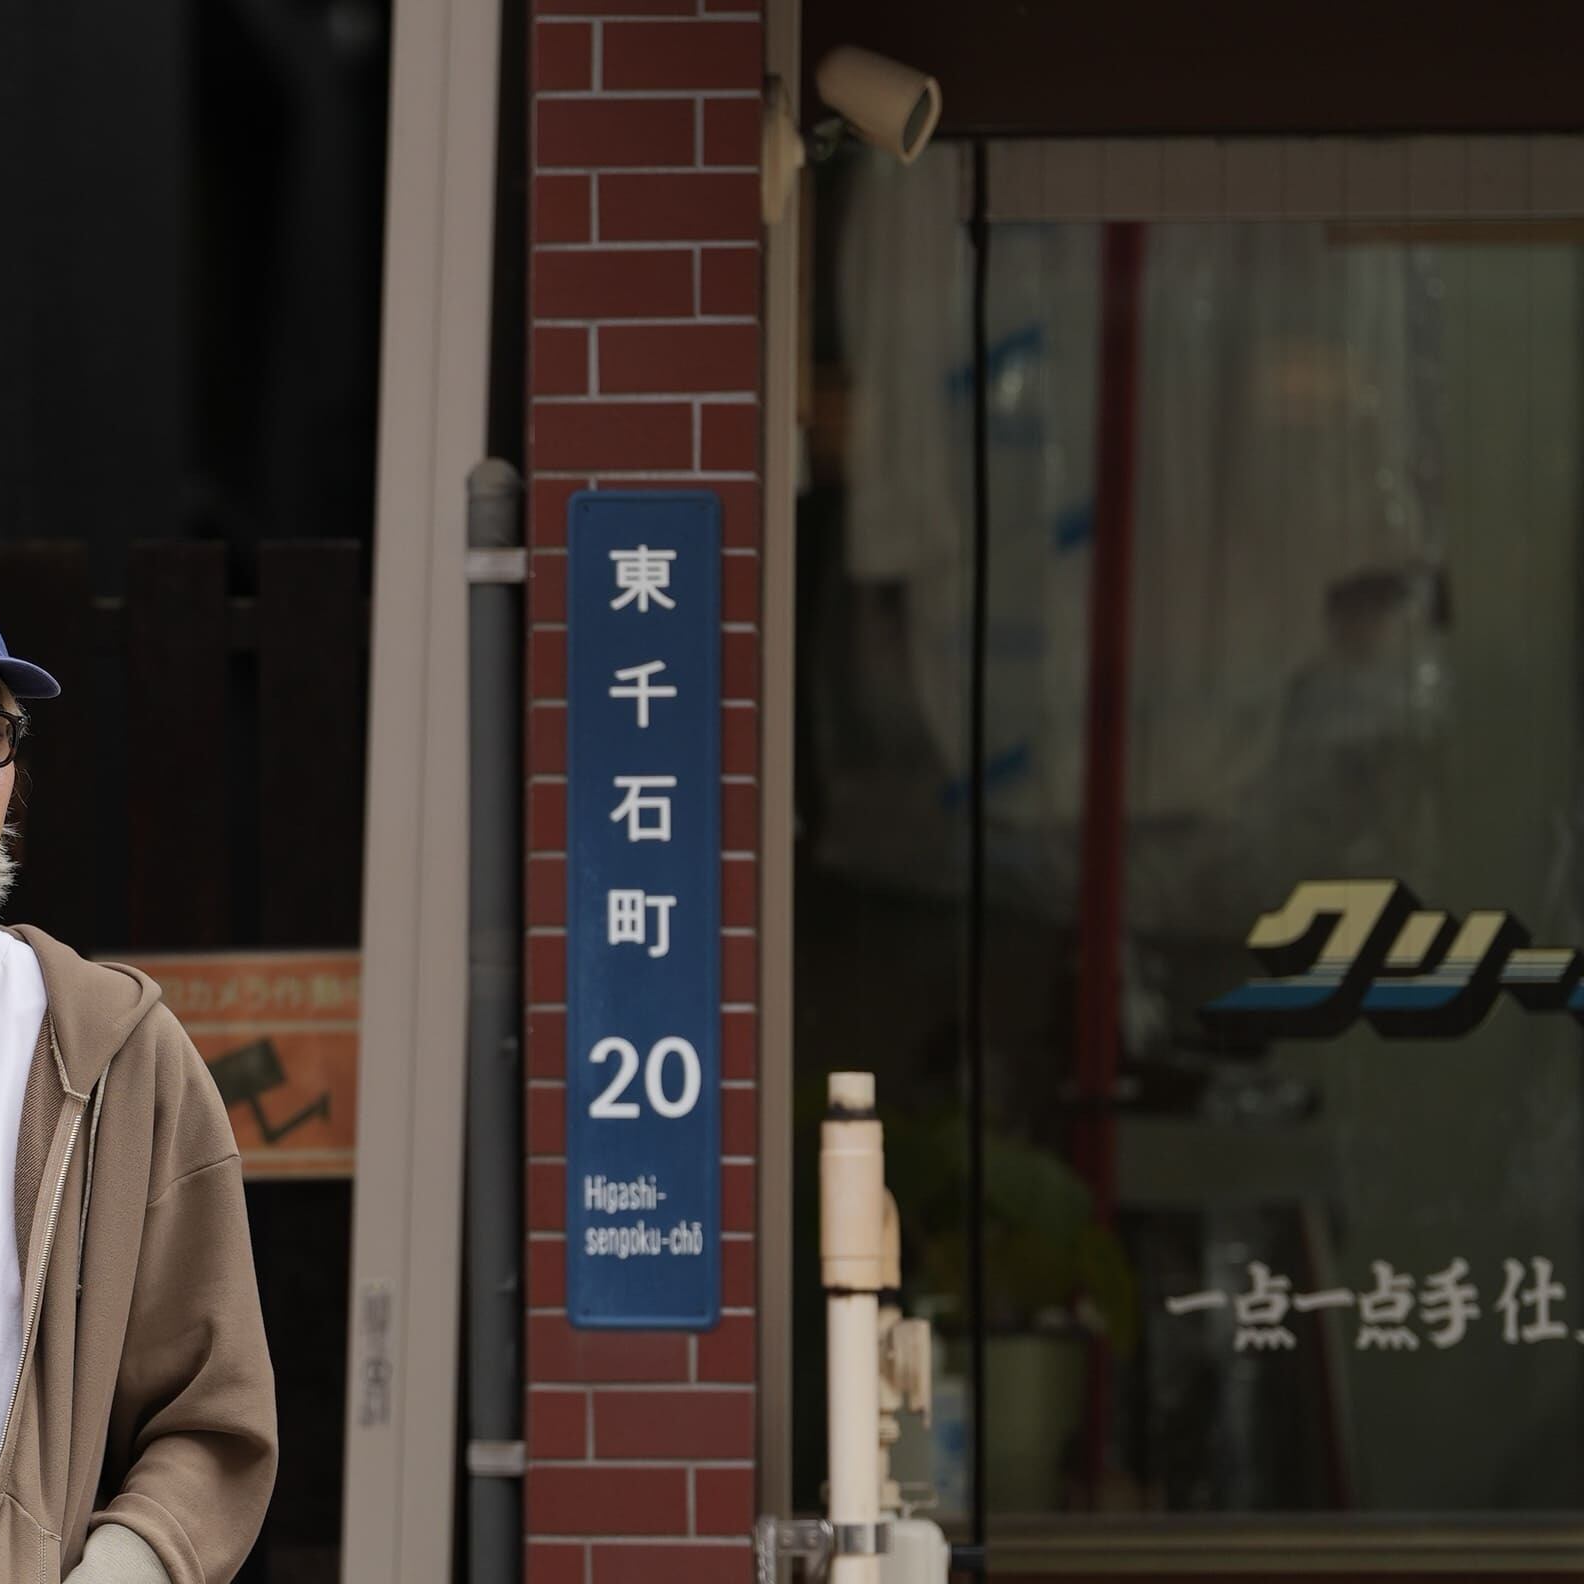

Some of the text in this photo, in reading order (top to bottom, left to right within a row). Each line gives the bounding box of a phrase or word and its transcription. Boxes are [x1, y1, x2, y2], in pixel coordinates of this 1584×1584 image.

[608, 544, 678, 958] 東千石町
[1203, 878, 1584, 1022] クリー
[588, 1035, 703, 1120] 20
[583, 1173, 668, 1215] Higashi-
[1164, 1255, 1584, 1352] 一点一点手仕
